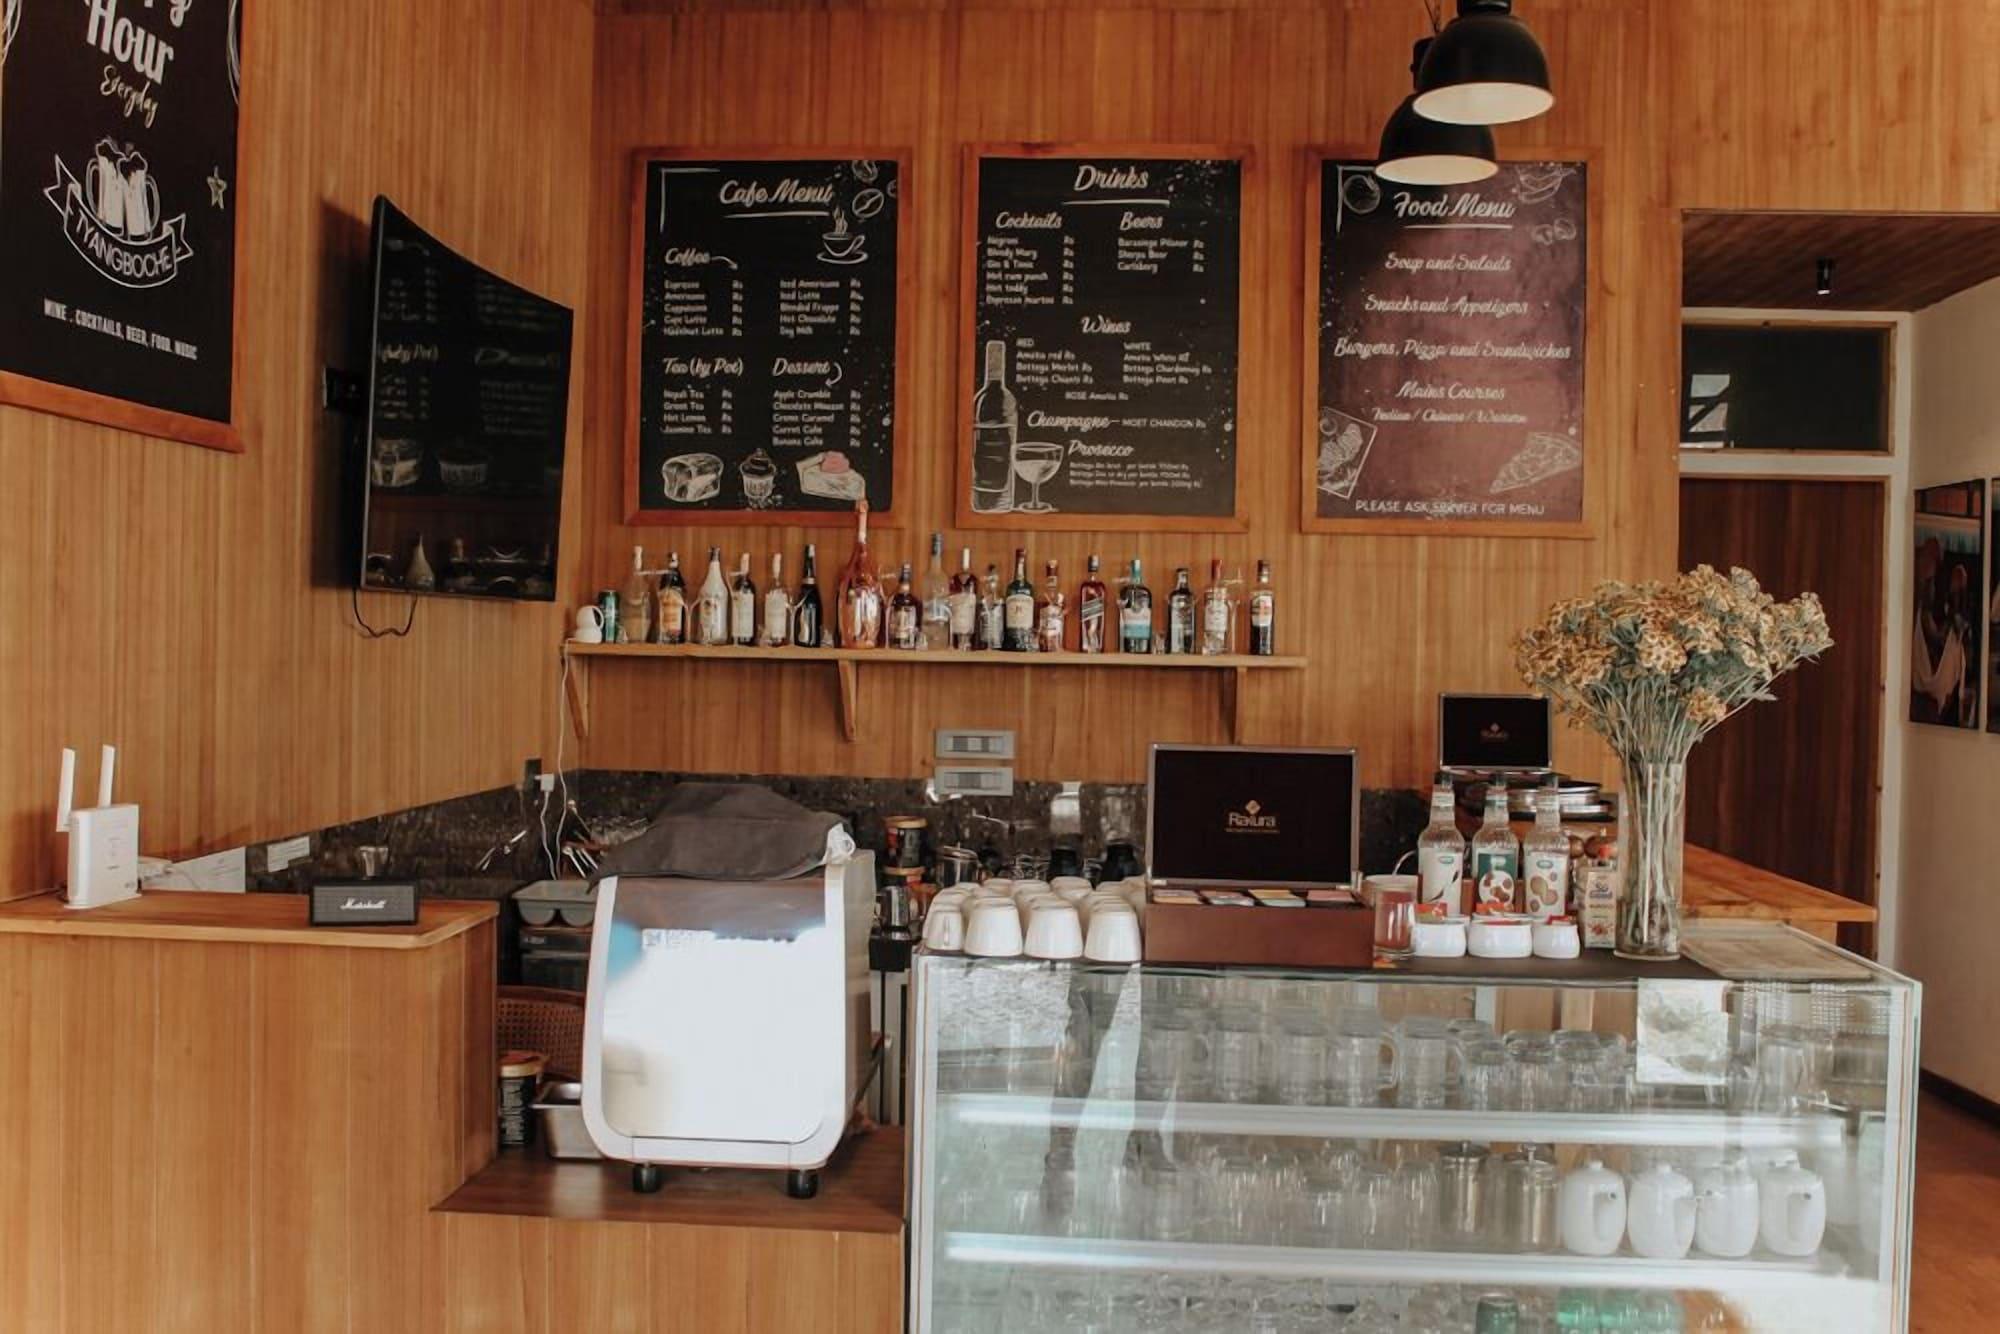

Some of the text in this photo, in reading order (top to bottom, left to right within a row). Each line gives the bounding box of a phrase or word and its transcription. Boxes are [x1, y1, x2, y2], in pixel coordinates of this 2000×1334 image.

[86, 0, 174, 85] Hour
[101, 64, 158, 128] Everyday
[1073, 164, 1149, 191] Drinks
[1393, 192, 1516, 218] Food Menu
[995, 211, 1062, 229] Cocktails
[1119, 211, 1163, 231] Beers
[665, 247, 710, 266] Coffee
[1385, 252, 1424, 274] Soup
[1456, 254, 1512, 271] Salads
[44, 298, 67, 320] WINE
[1365, 294, 1419, 311] Snacks
[1081, 313, 1131, 334] Wines
[1402, 339, 1446, 360] Pizza
[1068, 440, 1135, 457] Prosecco
[1355, 500, 1402, 512] PLEASE
[1509, 504, 1545, 515] MENU
[340, 897, 387, 910] Marshall
